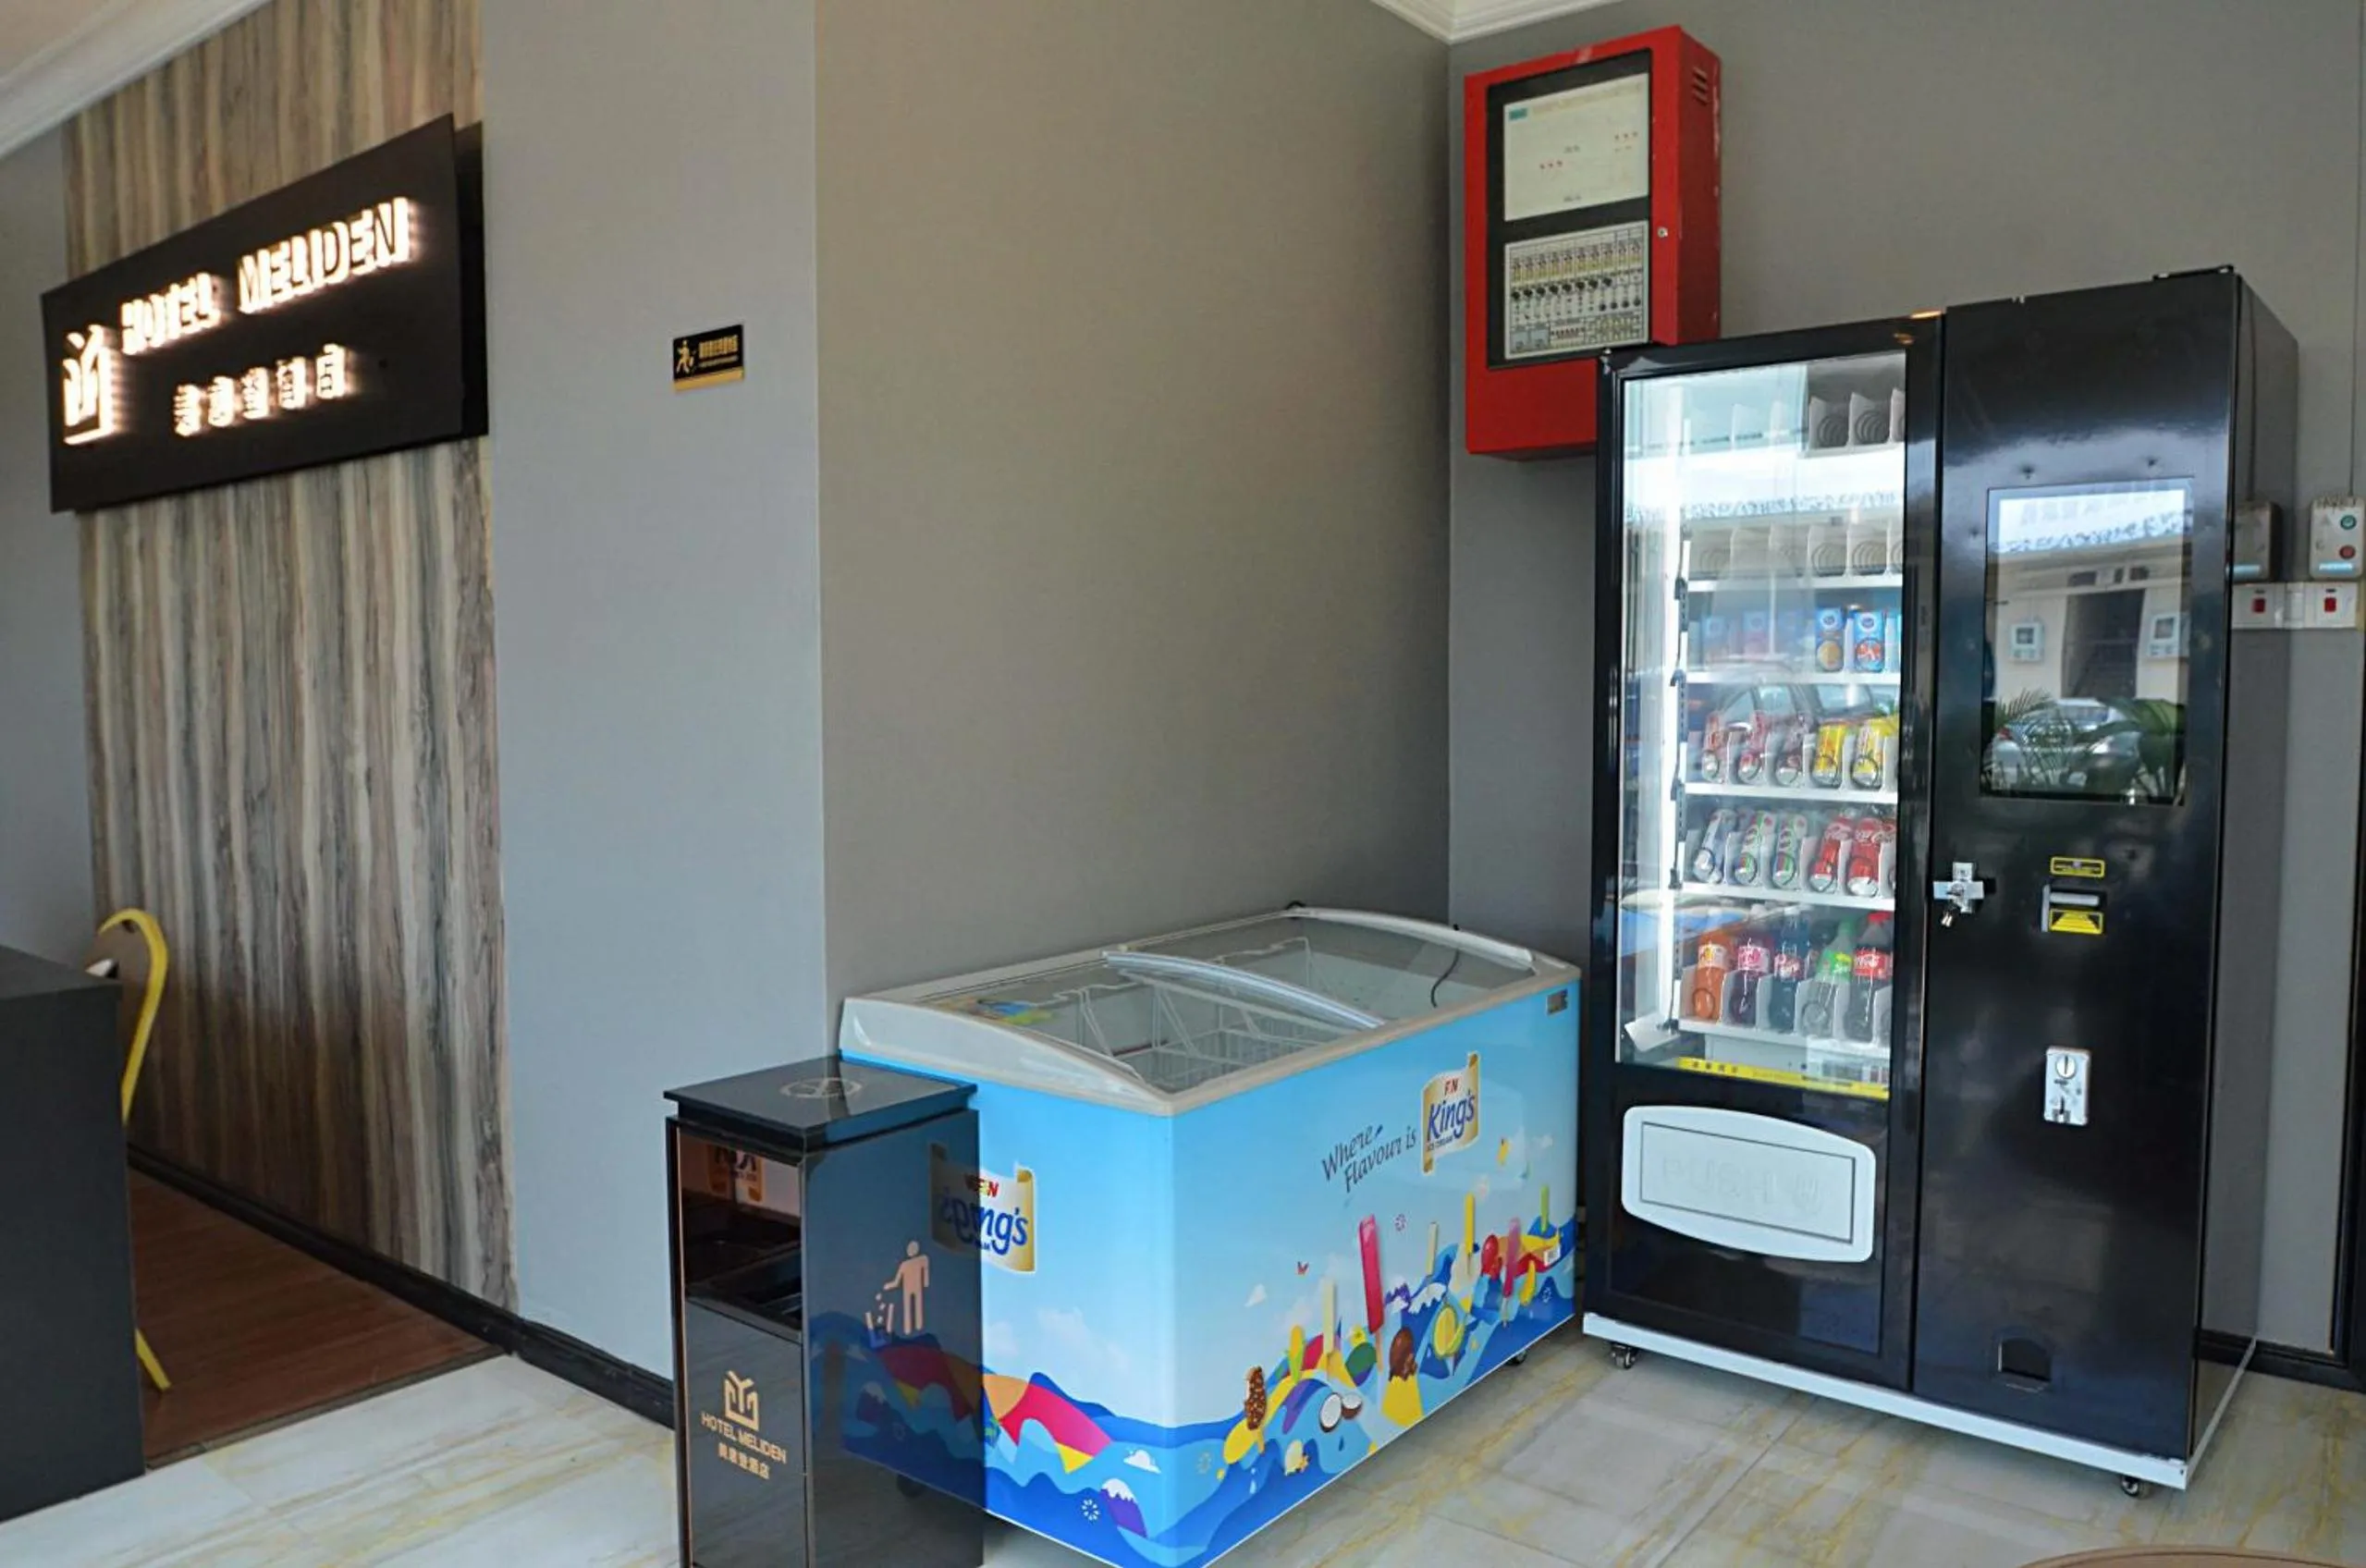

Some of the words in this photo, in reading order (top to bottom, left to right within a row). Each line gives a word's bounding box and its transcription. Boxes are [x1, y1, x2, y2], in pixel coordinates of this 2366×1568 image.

[237, 196, 411, 314] MELIDEN
[1427, 1089, 1476, 1142] King's
[1321, 1125, 1373, 1182] Where
[1343, 1137, 1403, 1194] Flavour
[1405, 1125, 1417, 1150] is
[701, 1410, 737, 1441] HOTEL
[738, 1428, 787, 1464] MELIDEN
